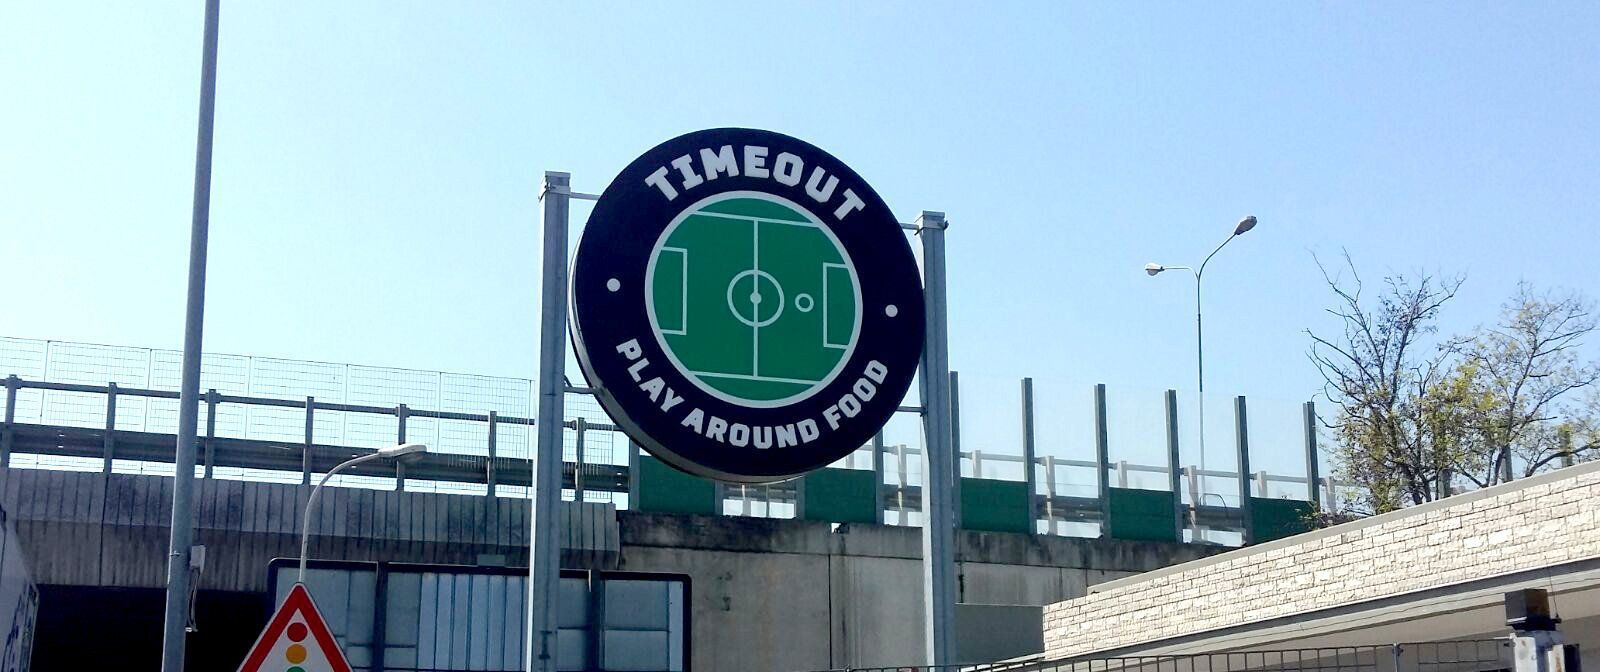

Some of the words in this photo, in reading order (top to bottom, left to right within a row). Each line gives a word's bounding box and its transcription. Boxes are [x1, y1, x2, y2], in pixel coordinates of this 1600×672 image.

[645, 145, 866, 221] TIMEOUT
[616, 338, 685, 413] PLAY
[681, 407, 820, 449] AROUND
[822, 359, 889, 431] FOOD
